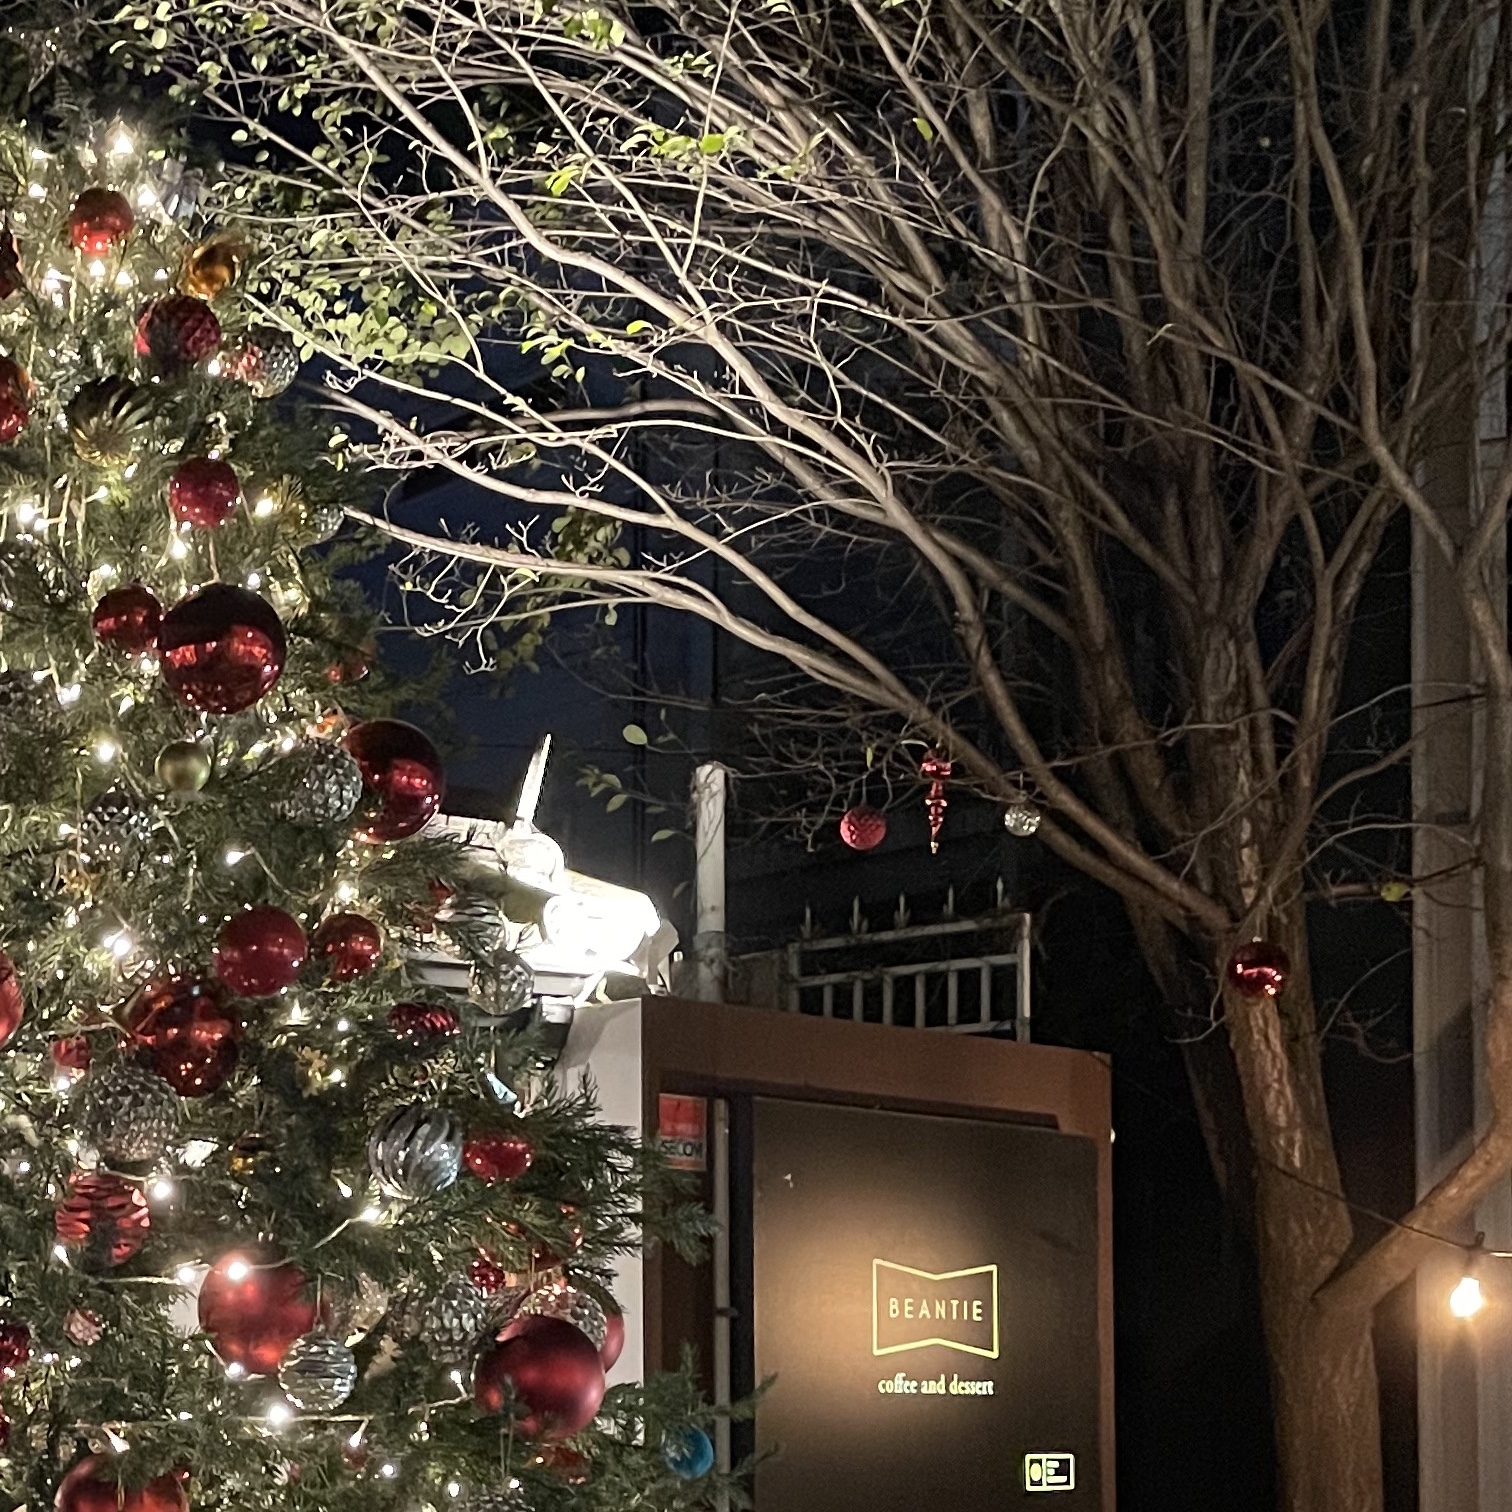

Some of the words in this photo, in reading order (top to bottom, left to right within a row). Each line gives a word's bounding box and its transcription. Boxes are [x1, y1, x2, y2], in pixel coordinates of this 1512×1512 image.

[889, 1297, 983, 1321] BEANTIE
[878, 1372, 918, 1394] coffee
[920, 1373, 946, 1394] and
[949, 1373, 994, 1395] dessert
